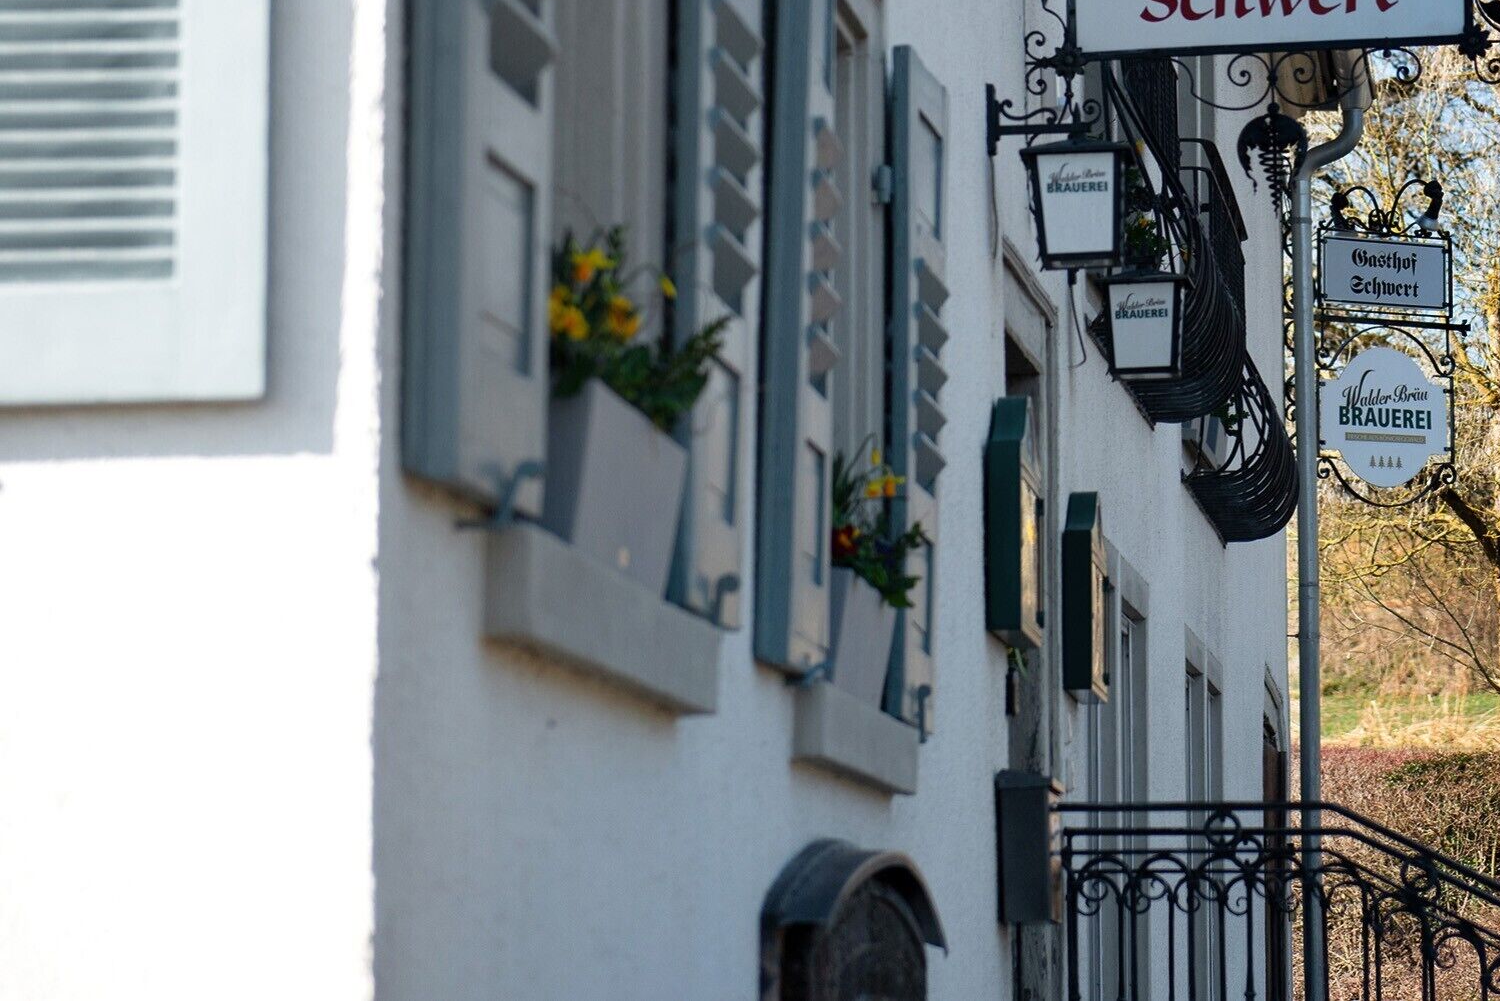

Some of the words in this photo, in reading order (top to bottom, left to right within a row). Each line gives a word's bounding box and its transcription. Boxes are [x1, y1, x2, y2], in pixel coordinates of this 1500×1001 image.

[1047, 181, 1108, 193] BRAUEREI
[1351, 247, 1418, 276] Gasthof
[1350, 275, 1420, 299] Schwert
[1115, 308, 1168, 320] BRAUEREI
[1342, 369, 1393, 409] Walder
[1393, 384, 1428, 403] Bräu
[1339, 406, 1432, 430] BRAUEREI
